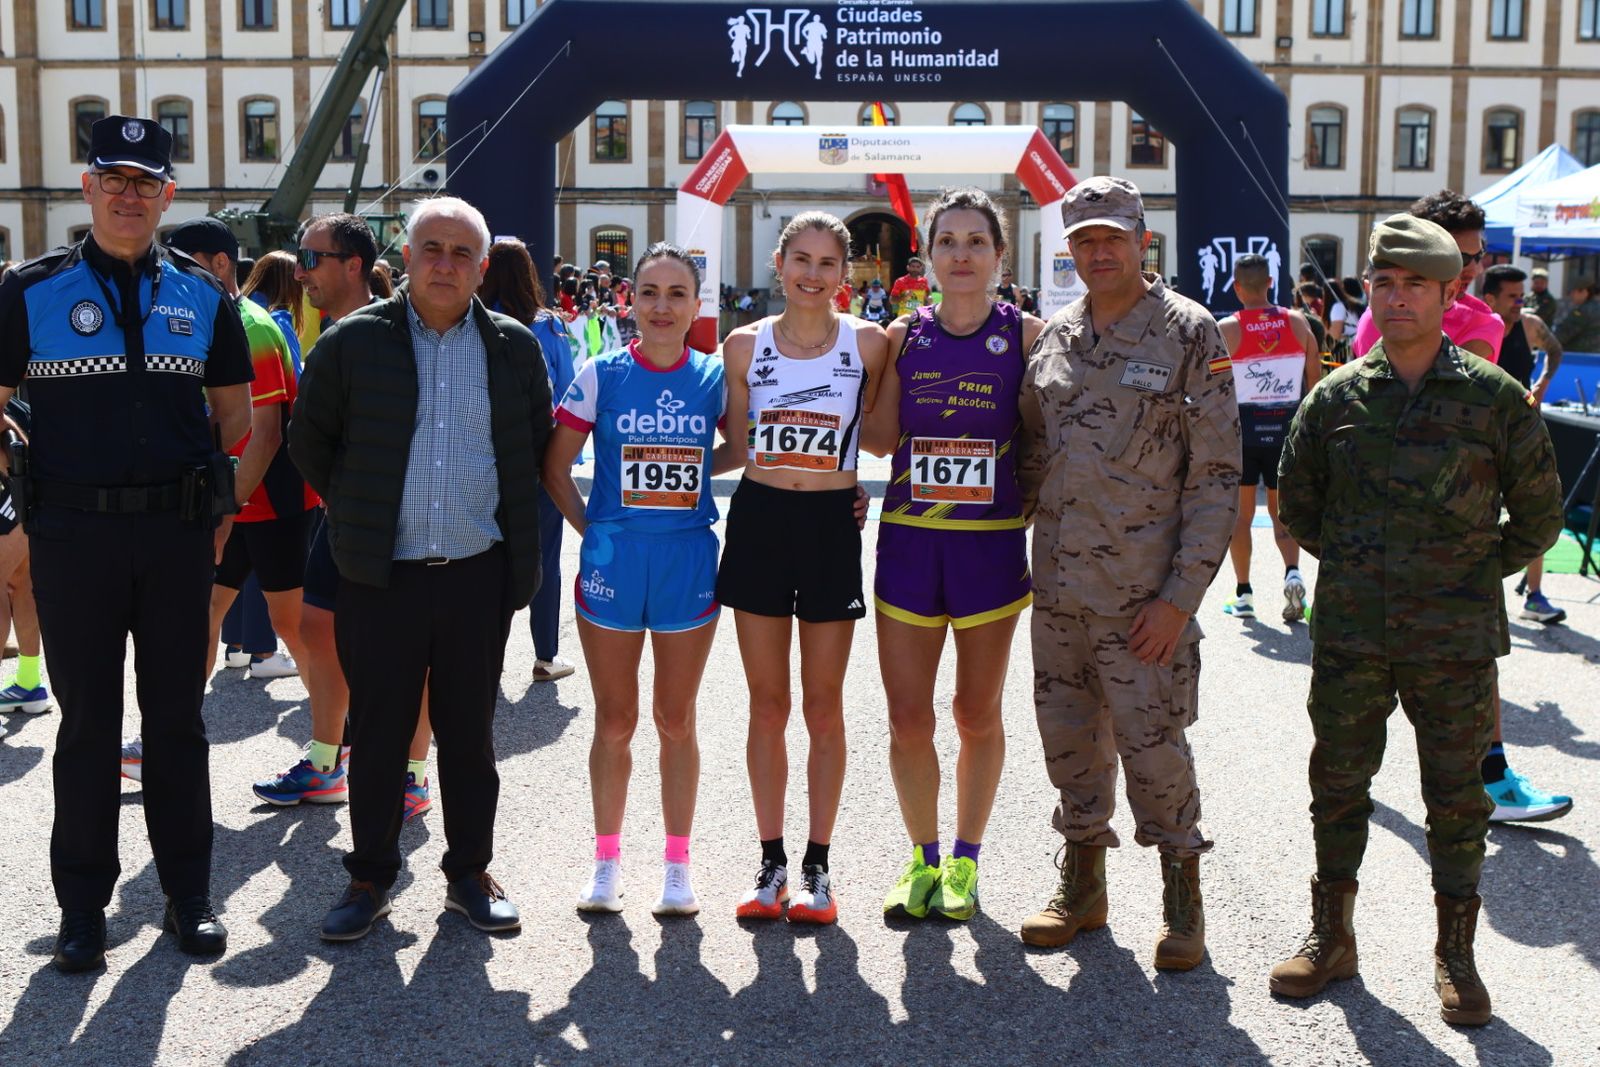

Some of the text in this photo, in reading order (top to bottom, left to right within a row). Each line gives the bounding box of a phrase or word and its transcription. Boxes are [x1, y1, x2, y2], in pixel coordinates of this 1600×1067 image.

[836, 7, 923, 23] Ciudades
[836, 27, 942, 45] Patrimonio
[836, 49, 999, 67] de la Humanidad
[837, 72, 942, 82] ESPAÑA UNESCO
[851, 138, 910, 147] Diputación
[864, 152, 921, 160] Salamanca
[1246, 319, 1286, 331] GASPAR
[912, 371, 941, 380] Jamón
[959, 381, 993, 395] PRIM
[948, 396, 997, 410] Macotera
[616, 409, 707, 435] debra
[781, 416, 819, 425] CARRERA
[629, 435, 645, 443] Piel
[660, 436, 698, 444] Mariposa
[761, 425, 837, 455] 1674
[914, 440, 932, 453] XIV
[934, 447, 972, 455] CARRERA
[626, 463, 699, 491] 1953
[915, 456, 988, 485] 1671
